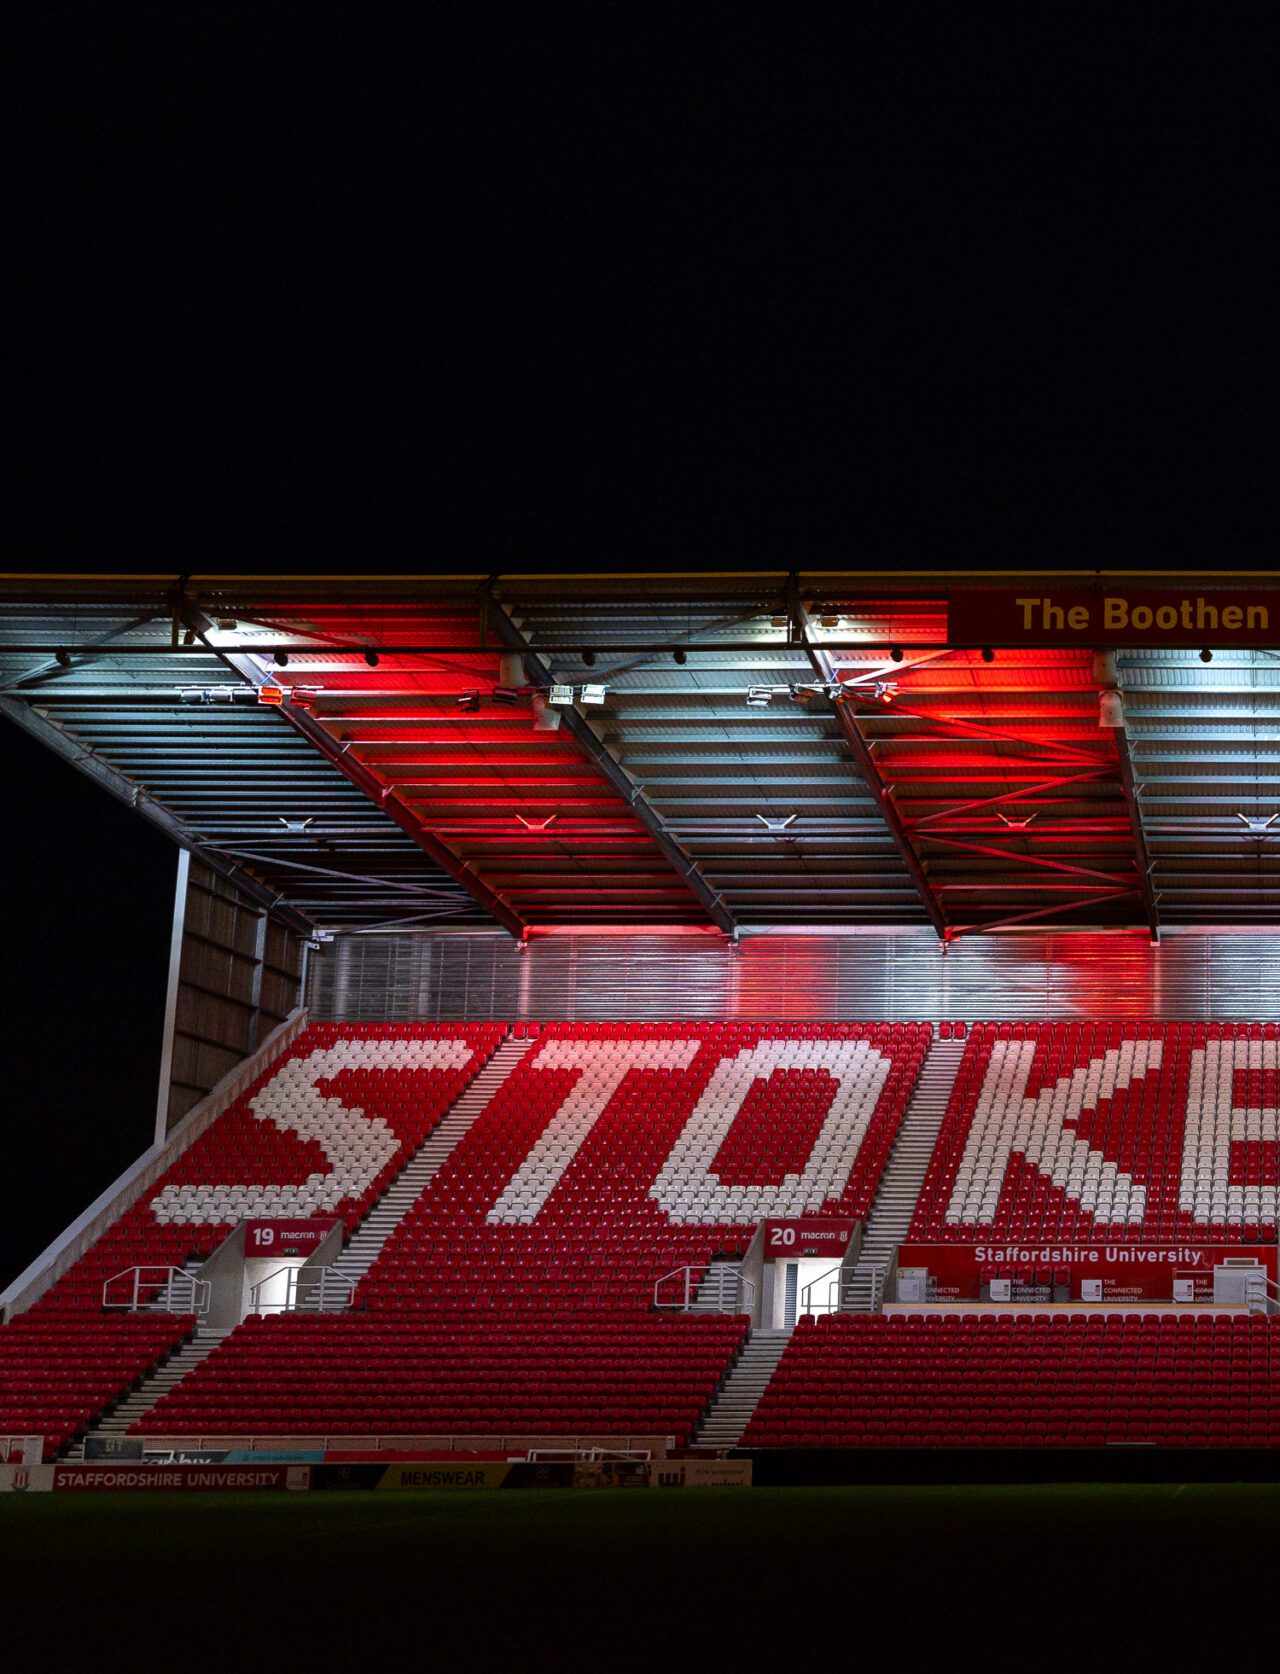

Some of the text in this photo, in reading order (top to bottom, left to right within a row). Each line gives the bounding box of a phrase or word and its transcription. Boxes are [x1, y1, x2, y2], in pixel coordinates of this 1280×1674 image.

[1015, 597, 1090, 630] The
[1102, 597, 1269, 630] Boothen
[252, 1227, 315, 1245] 19 macron
[770, 1227, 836, 1246] 20 macron
[974, 1246, 1201, 1266] Staffordshire University
[925, 1287, 960, 1295] ONNECTED
[1011, 1287, 1051, 1295] CONNECTED
[1103, 1287, 1143, 1295] CONNECTED
[57, 1471, 280, 1487] STAFFORDSHIRE UNIVERSITY
[400, 1471, 485, 1486] MENSWEAR
